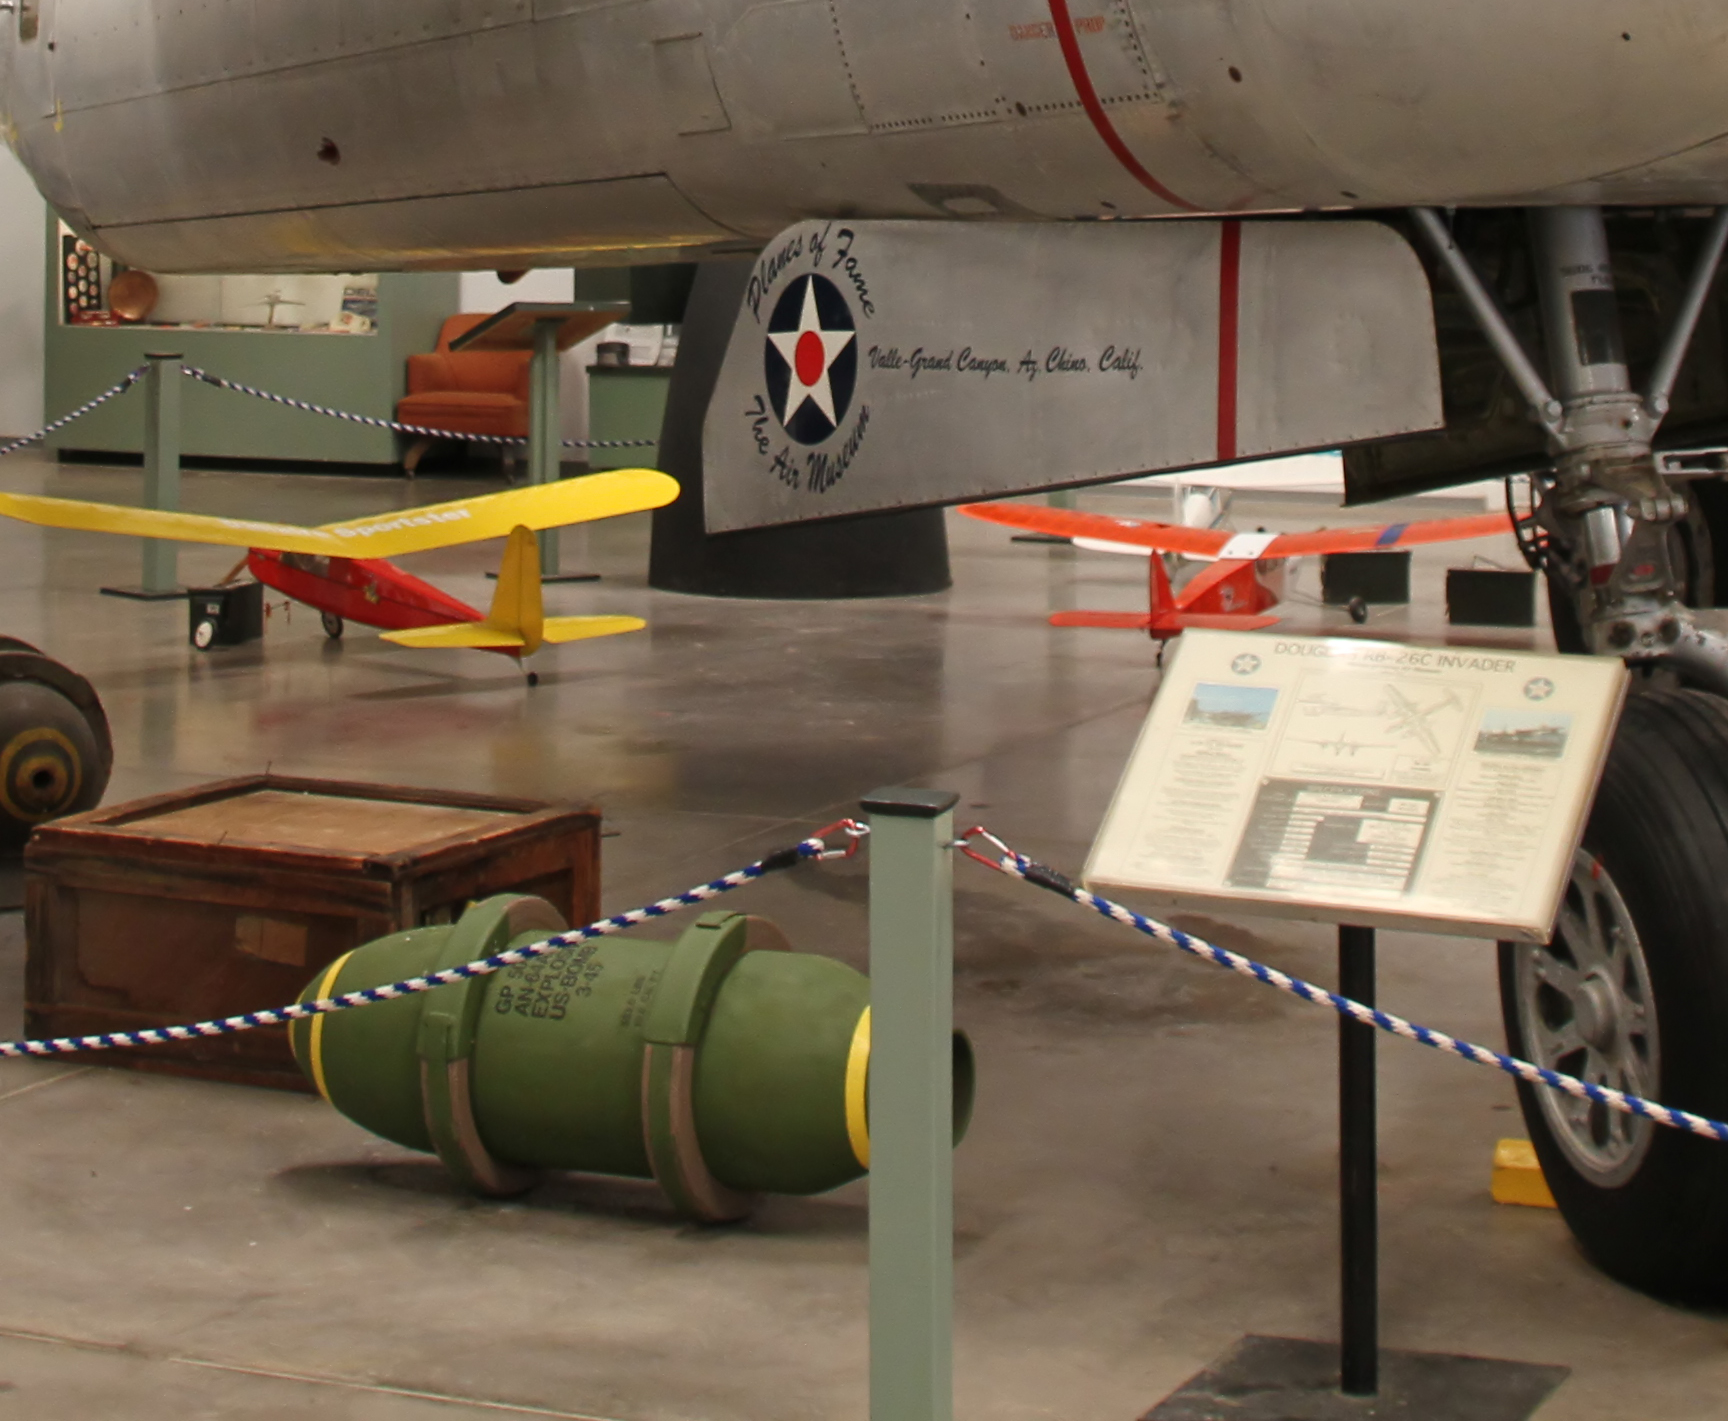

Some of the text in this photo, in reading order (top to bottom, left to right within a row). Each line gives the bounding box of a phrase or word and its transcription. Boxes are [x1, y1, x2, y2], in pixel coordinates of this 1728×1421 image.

[747, 222, 875, 325] Planes of Fame
[869, 346, 954, 379] Valle-Grand
[745, 394, 871, 495] The Air Museum
[1437, 655, 1516, 674] INVADER
[495, 985, 514, 1014] GP
